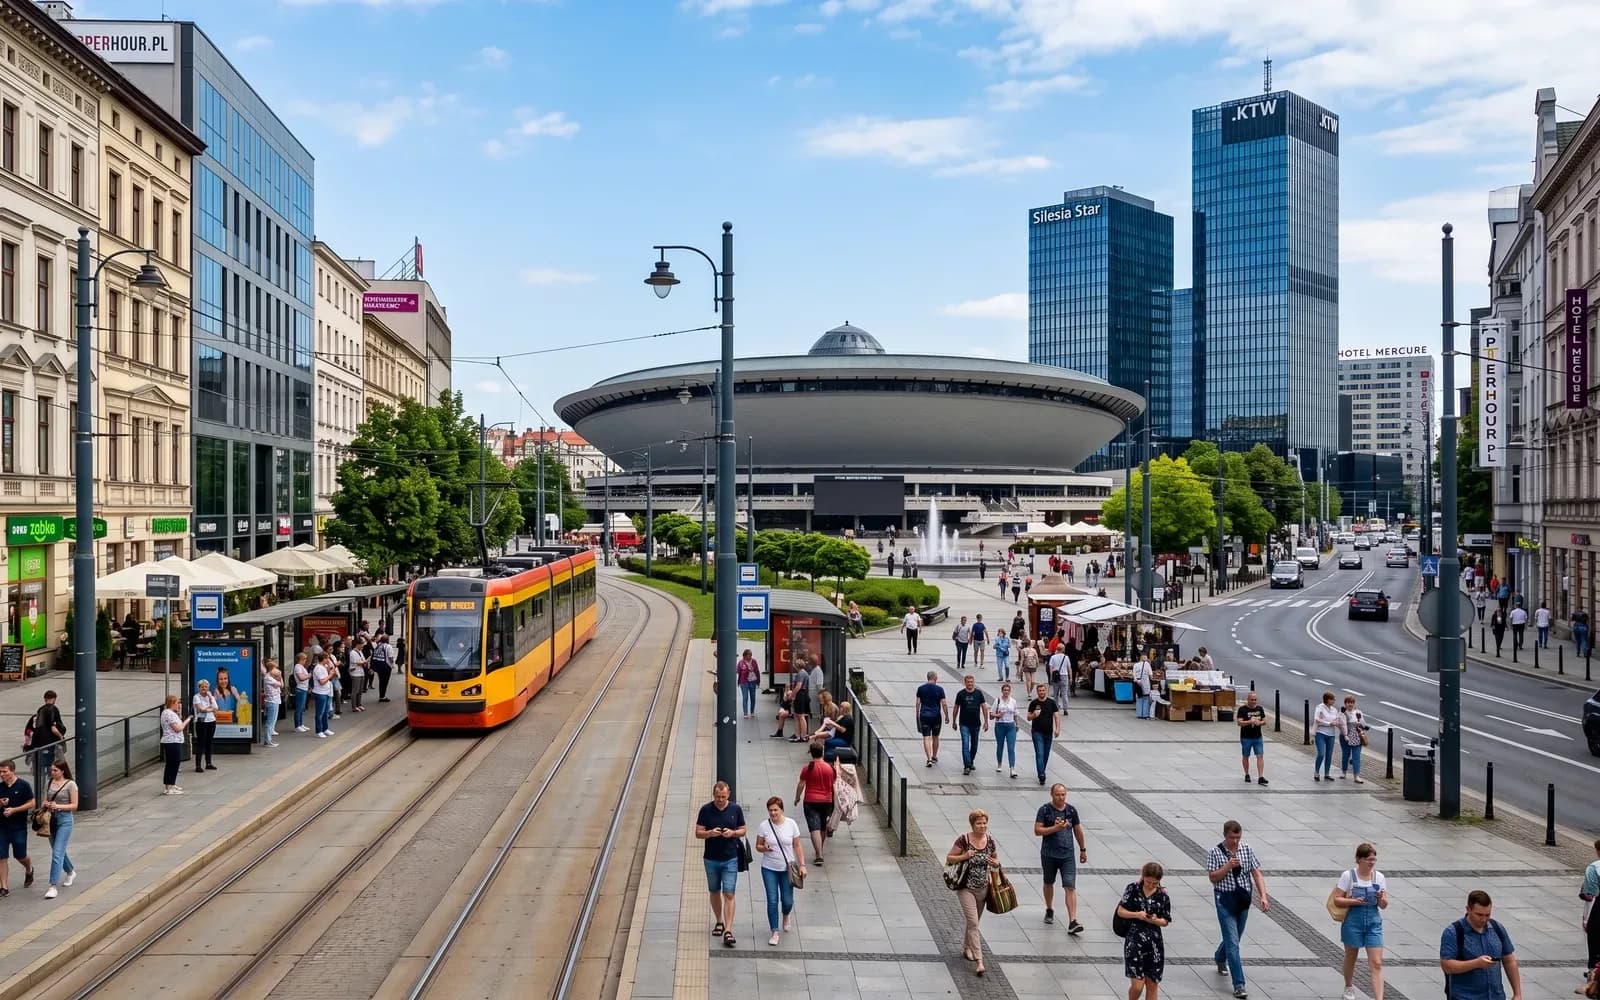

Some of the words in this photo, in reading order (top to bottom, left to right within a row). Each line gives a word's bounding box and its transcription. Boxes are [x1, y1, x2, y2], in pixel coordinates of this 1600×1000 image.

[1232, 99, 1277, 121] .KTW
[1319, 113, 1338, 134] .KTW
[1033, 207, 1072, 224] Silesia
[1075, 204, 1101, 218] Star
[1571, 296, 1582, 344] HOTEL
[1338, 348, 1371, 358] HOTEL
[1375, 345, 1427, 356] MERCURE
